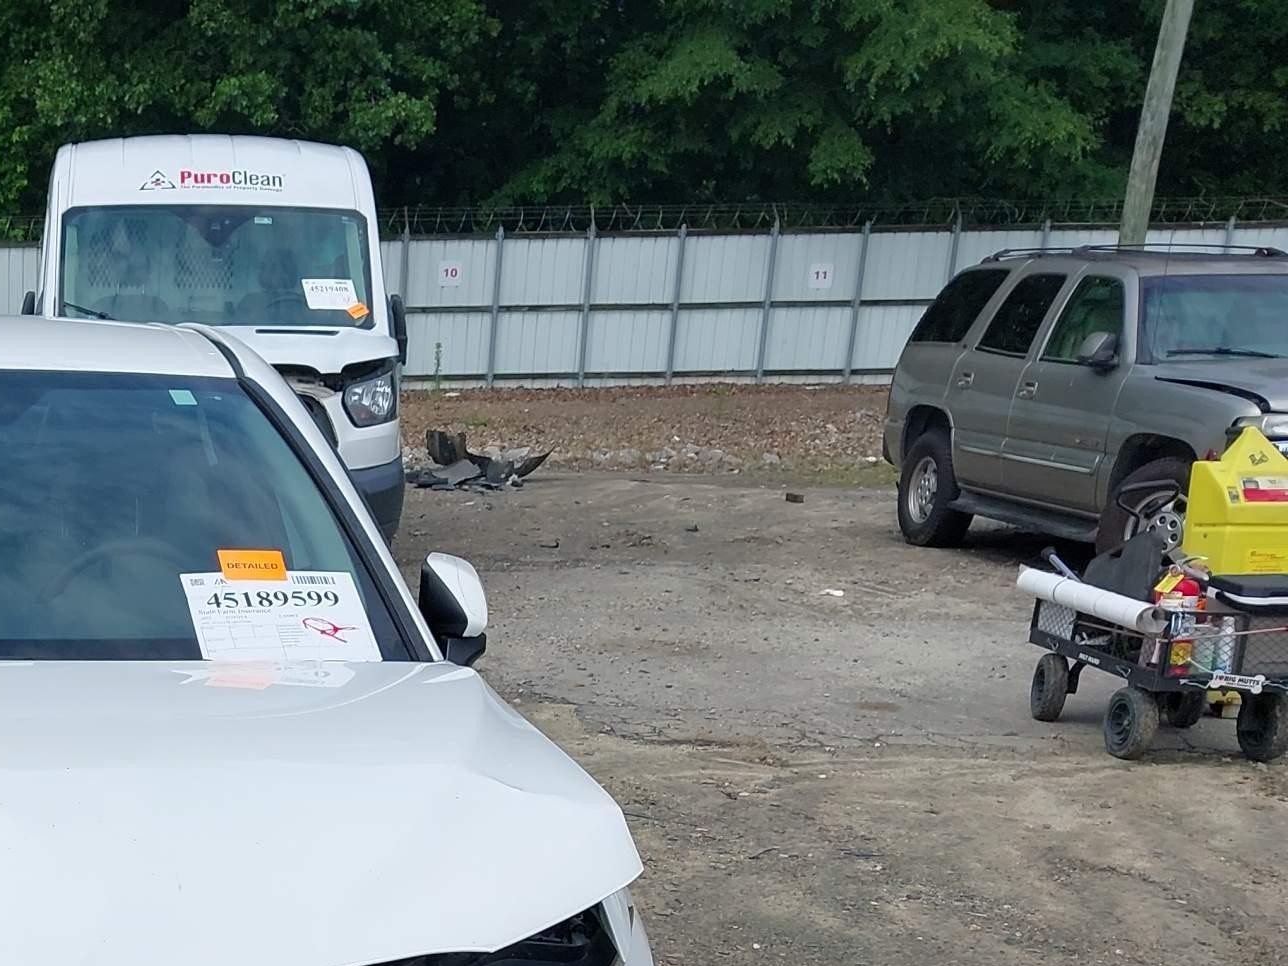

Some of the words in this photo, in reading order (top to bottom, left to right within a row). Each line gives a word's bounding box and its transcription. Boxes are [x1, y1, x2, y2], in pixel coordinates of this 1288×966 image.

[179, 170, 283, 188] PuroClean
[444, 268, 458, 278] 10
[815, 270, 827, 280] 11
[226, 562, 279, 570] DETAILED
[206, 590, 340, 609] 45189599
